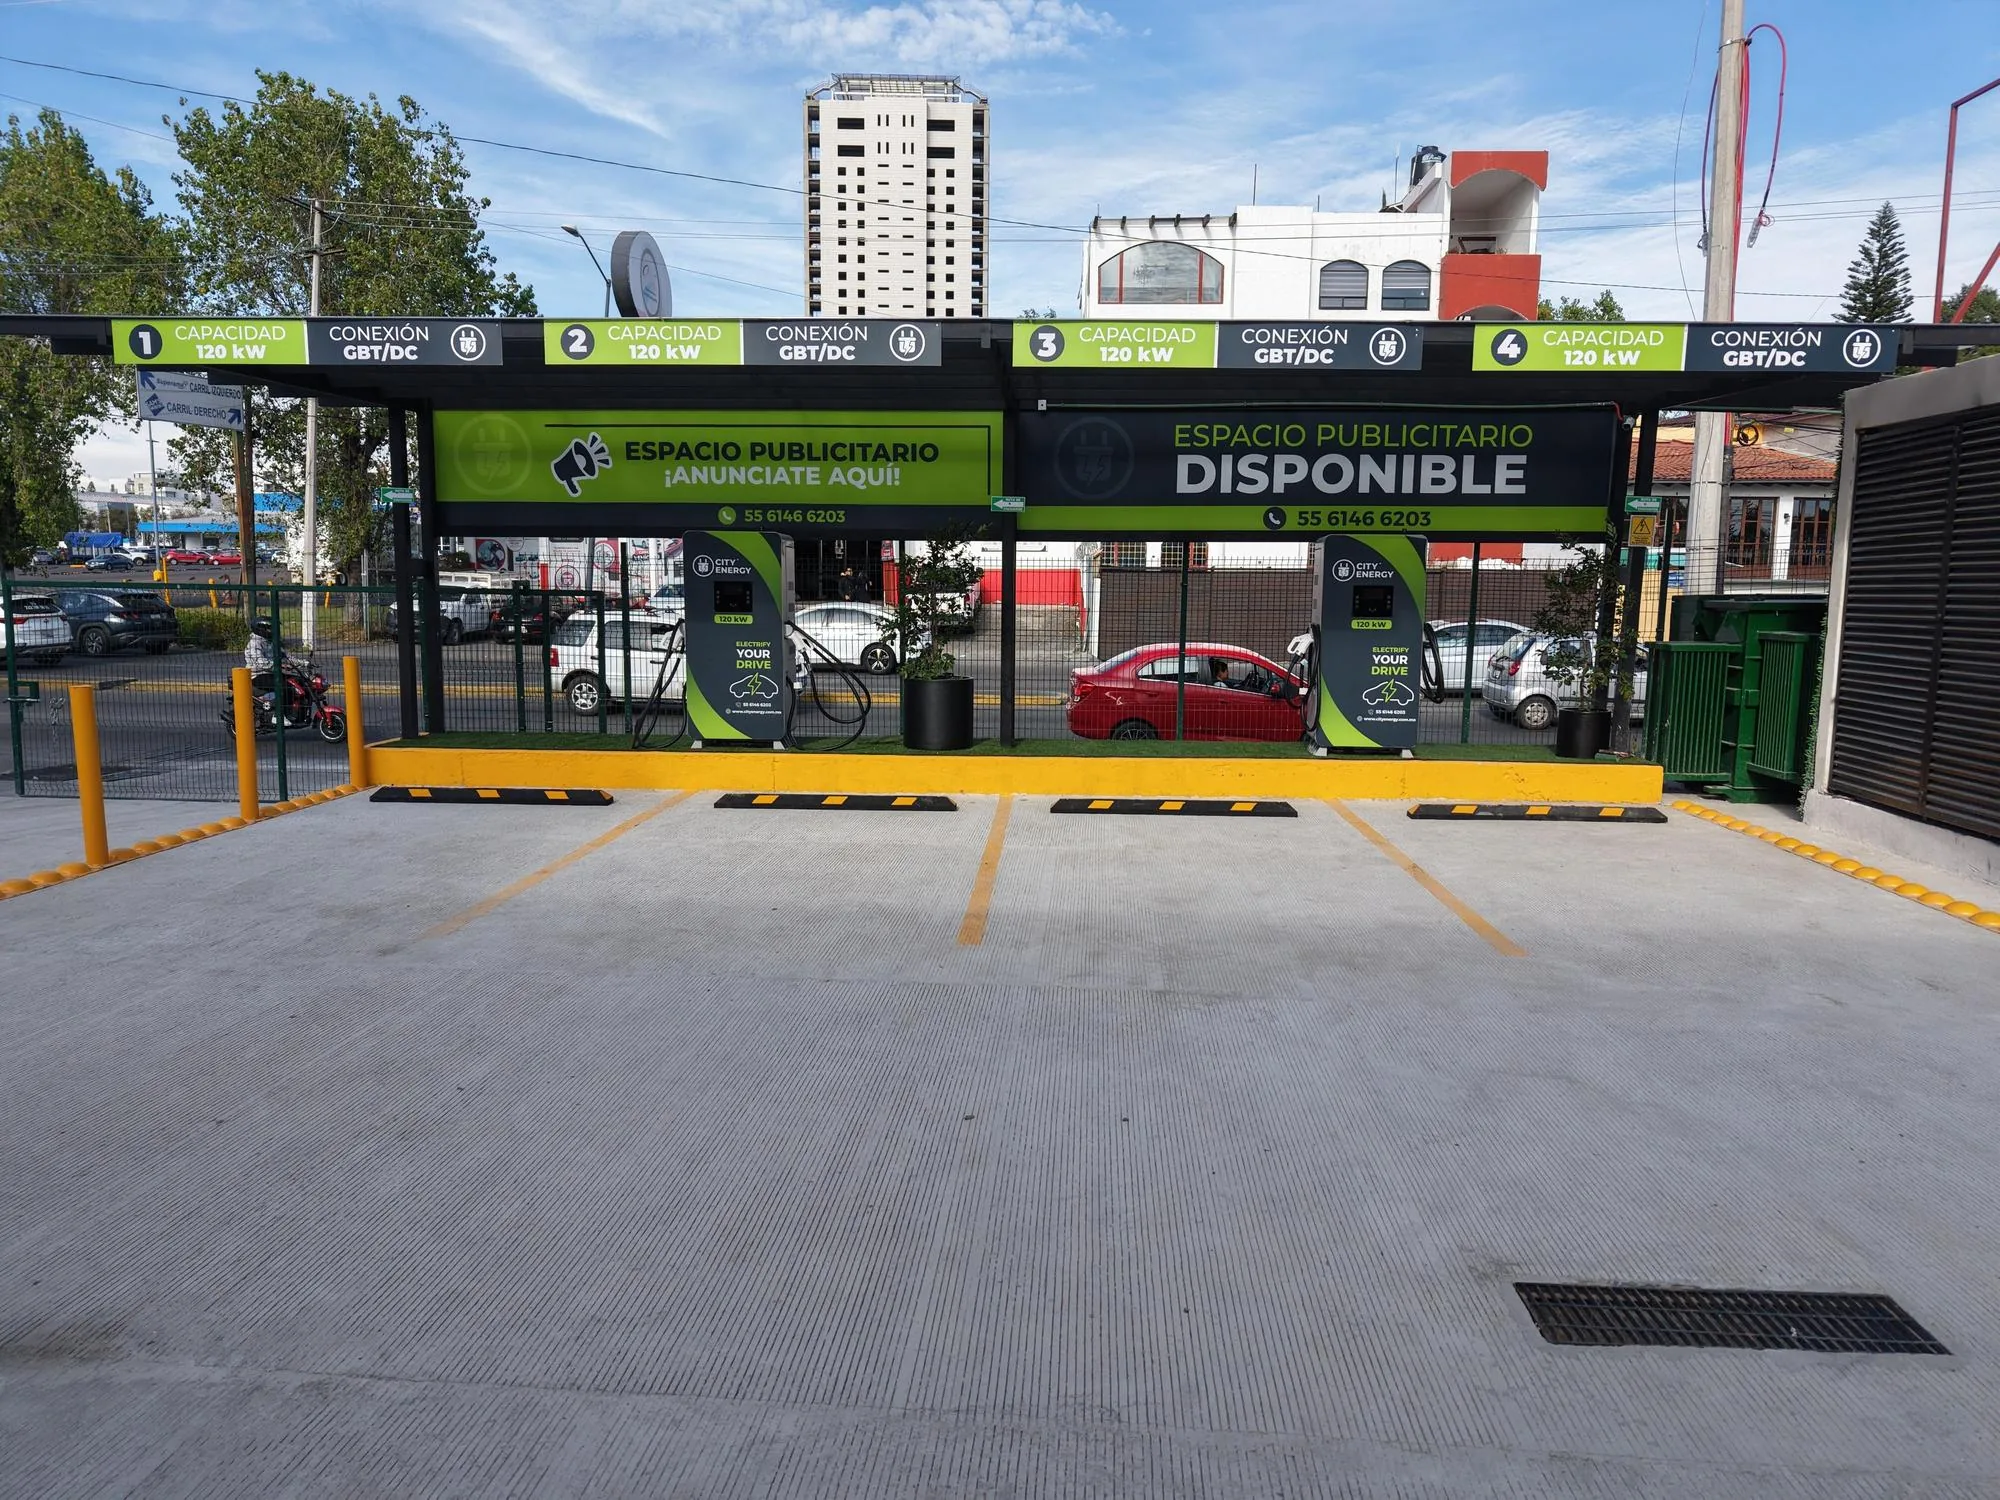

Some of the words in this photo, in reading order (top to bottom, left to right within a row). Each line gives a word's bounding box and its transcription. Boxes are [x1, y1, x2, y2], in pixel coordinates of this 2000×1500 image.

[176, 326, 285, 340] CAPACIDAD
[330, 323, 428, 341] CONEXIÓN
[608, 326, 721, 340] CAPACIDAD
[766, 321, 867, 340] CONEXIÓN
[1080, 327, 1195, 342] CAPACIDAD
[1242, 323, 1348, 343] CONEXIÓN
[1544, 331, 1663, 345] CAPACIDAD
[1712, 328, 1821, 346] CONEXIÓN
[139, 332, 151, 354] 1
[568, 328, 588, 353] 2
[1038, 332, 1056, 357] 3
[1497, 333, 1520, 358] 4
[196, 345, 227, 358] 120
[233, 344, 265, 358] kW
[344, 343, 418, 361] GBT/DC
[629, 345, 660, 359] 120
[666, 344, 700, 359] kW
[780, 343, 855, 361] GBT/DC
[1100, 347, 1132, 361] 120
[1138, 347, 1173, 362] kW
[1255, 346, 1333, 365] GBT/DC
[1564, 350, 1597, 365] 120
[1603, 350, 1640, 365] kW
[1724, 348, 1806, 368] GBT/DC
[190, 383, 210, 394] CARRIL
[211, 386, 241, 399] IZQUIERDO
[167, 402, 192, 415] CARRIL
[194, 406, 227, 419] DERECHO
[1175, 425, 1305, 446] ESPACIO
[1318, 425, 1532, 447] PUBLICITARIO
[626, 440, 741, 461] ESPACIO
[750, 440, 939, 463] PUBLICITARIO
[665, 466, 820, 487] ¡ANUNCIATE
[829, 461, 899, 489] AQUÍ!
[1177, 454, 1526, 494] DISPONIBLE
[745, 510, 762, 521] 55
[767, 510, 802, 522] 6146
[807, 511, 845, 522] 6203
[1298, 511, 1321, 526] 55
[1328, 511, 1374, 526] 6146
[1380, 511, 1431, 526] 6203
[715, 558, 736, 566] CITY
[715, 566, 751, 574] ENERGY
[1356, 562, 1378, 570] CITY
[736, 649, 770, 658] YOUR
[1372, 655, 1408, 664] YOUR
[736, 660, 771, 669] DRIVE
[1371, 666, 1408, 675] DRIVE
